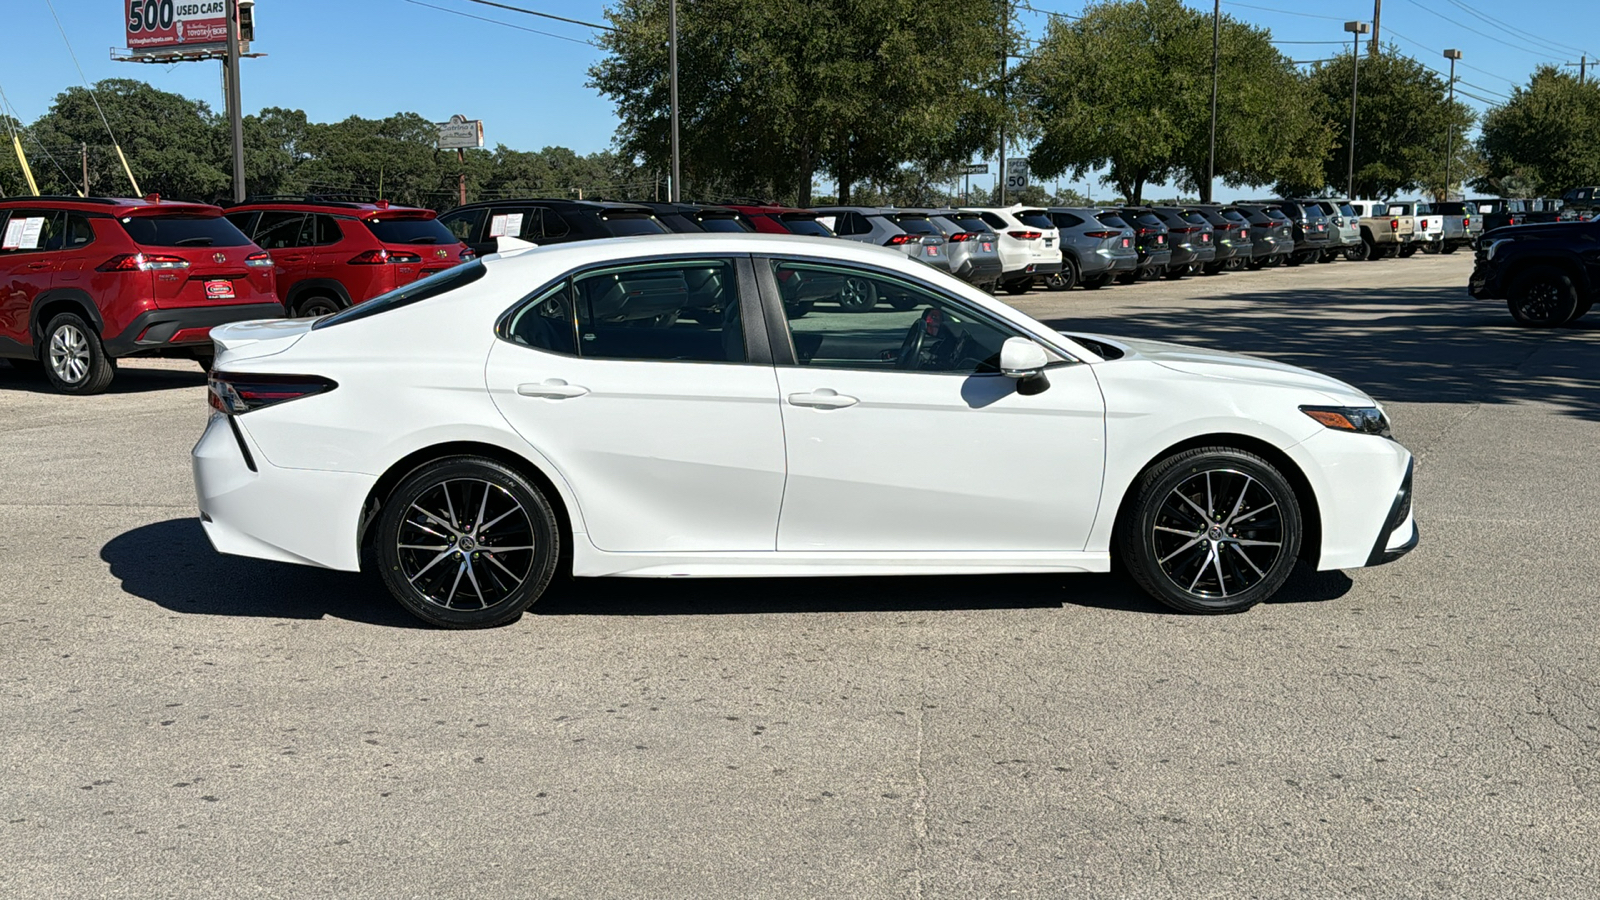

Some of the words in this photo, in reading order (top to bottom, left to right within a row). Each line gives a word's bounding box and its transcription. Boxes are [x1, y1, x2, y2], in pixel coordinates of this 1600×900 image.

[128, 0, 173, 32] 500
[176, 4, 199, 16] USED
[200, 2, 224, 14] CARS
[1008, 176, 1025, 187] 50
